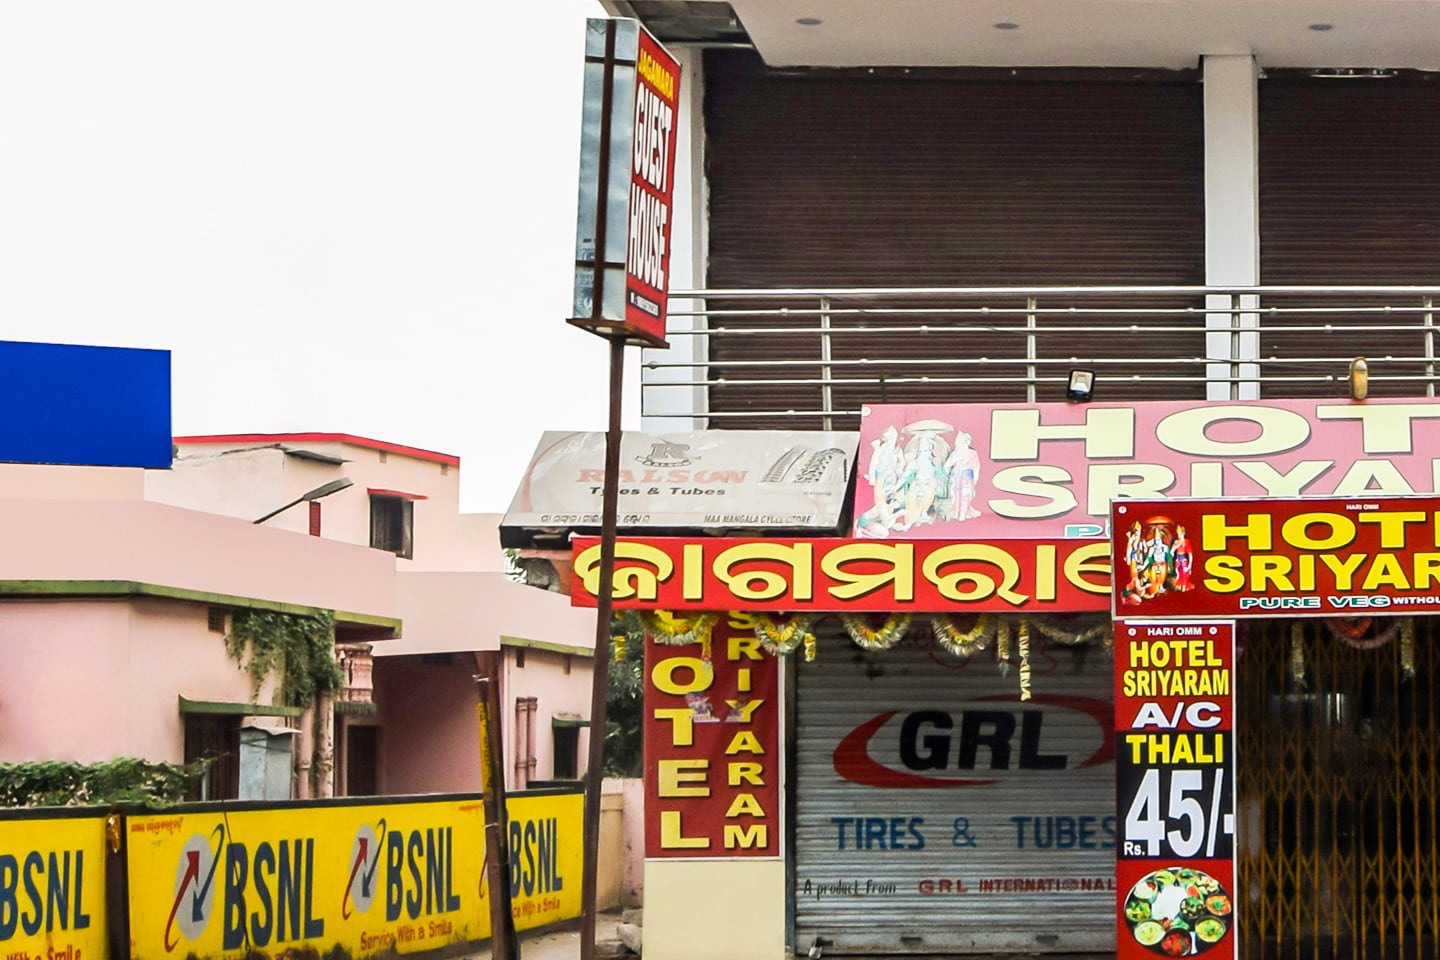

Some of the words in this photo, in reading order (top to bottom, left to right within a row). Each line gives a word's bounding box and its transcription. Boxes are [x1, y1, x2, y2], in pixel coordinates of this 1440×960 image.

[634, 82, 672, 193] GUEST
[629, 183, 667, 291] HOUSE
[647, 487, 660, 495] &
[670, 487, 726, 496] Tubes
[1240, 596, 1321, 609] PURE
[1327, 595, 1391, 608] VEG
[1147, 627, 1173, 636] HARI
[1176, 626, 1203, 636] OMM
[1129, 640, 1223, 668] HOTEL
[1123, 669, 1229, 697] SRIYARAM
[1132, 701, 1222, 729] A/C
[899, 709, 1068, 771] GRL
[1126, 733, 1224, 764] THALI
[1125, 768, 1234, 858] 45/-
[830, 816, 925, 850] TIRES
[952, 816, 977, 848] &
[1010, 815, 1117, 850] TUBES
[509, 817, 563, 898] BSNL
[1124, 841, 1146, 856] Rs.
[386, 827, 460, 922] BSNL
[803, 878, 813, 896] A
[816, 879, 861, 901] product
[918, 879, 968, 895] GRL
[978, 878, 1116, 893] INTERNATIONAL
[0, 850, 91, 941] BSNL
[222, 837, 325, 951] BSNL
[397, 924, 416, 943] With
[418, 926, 425, 940] a
